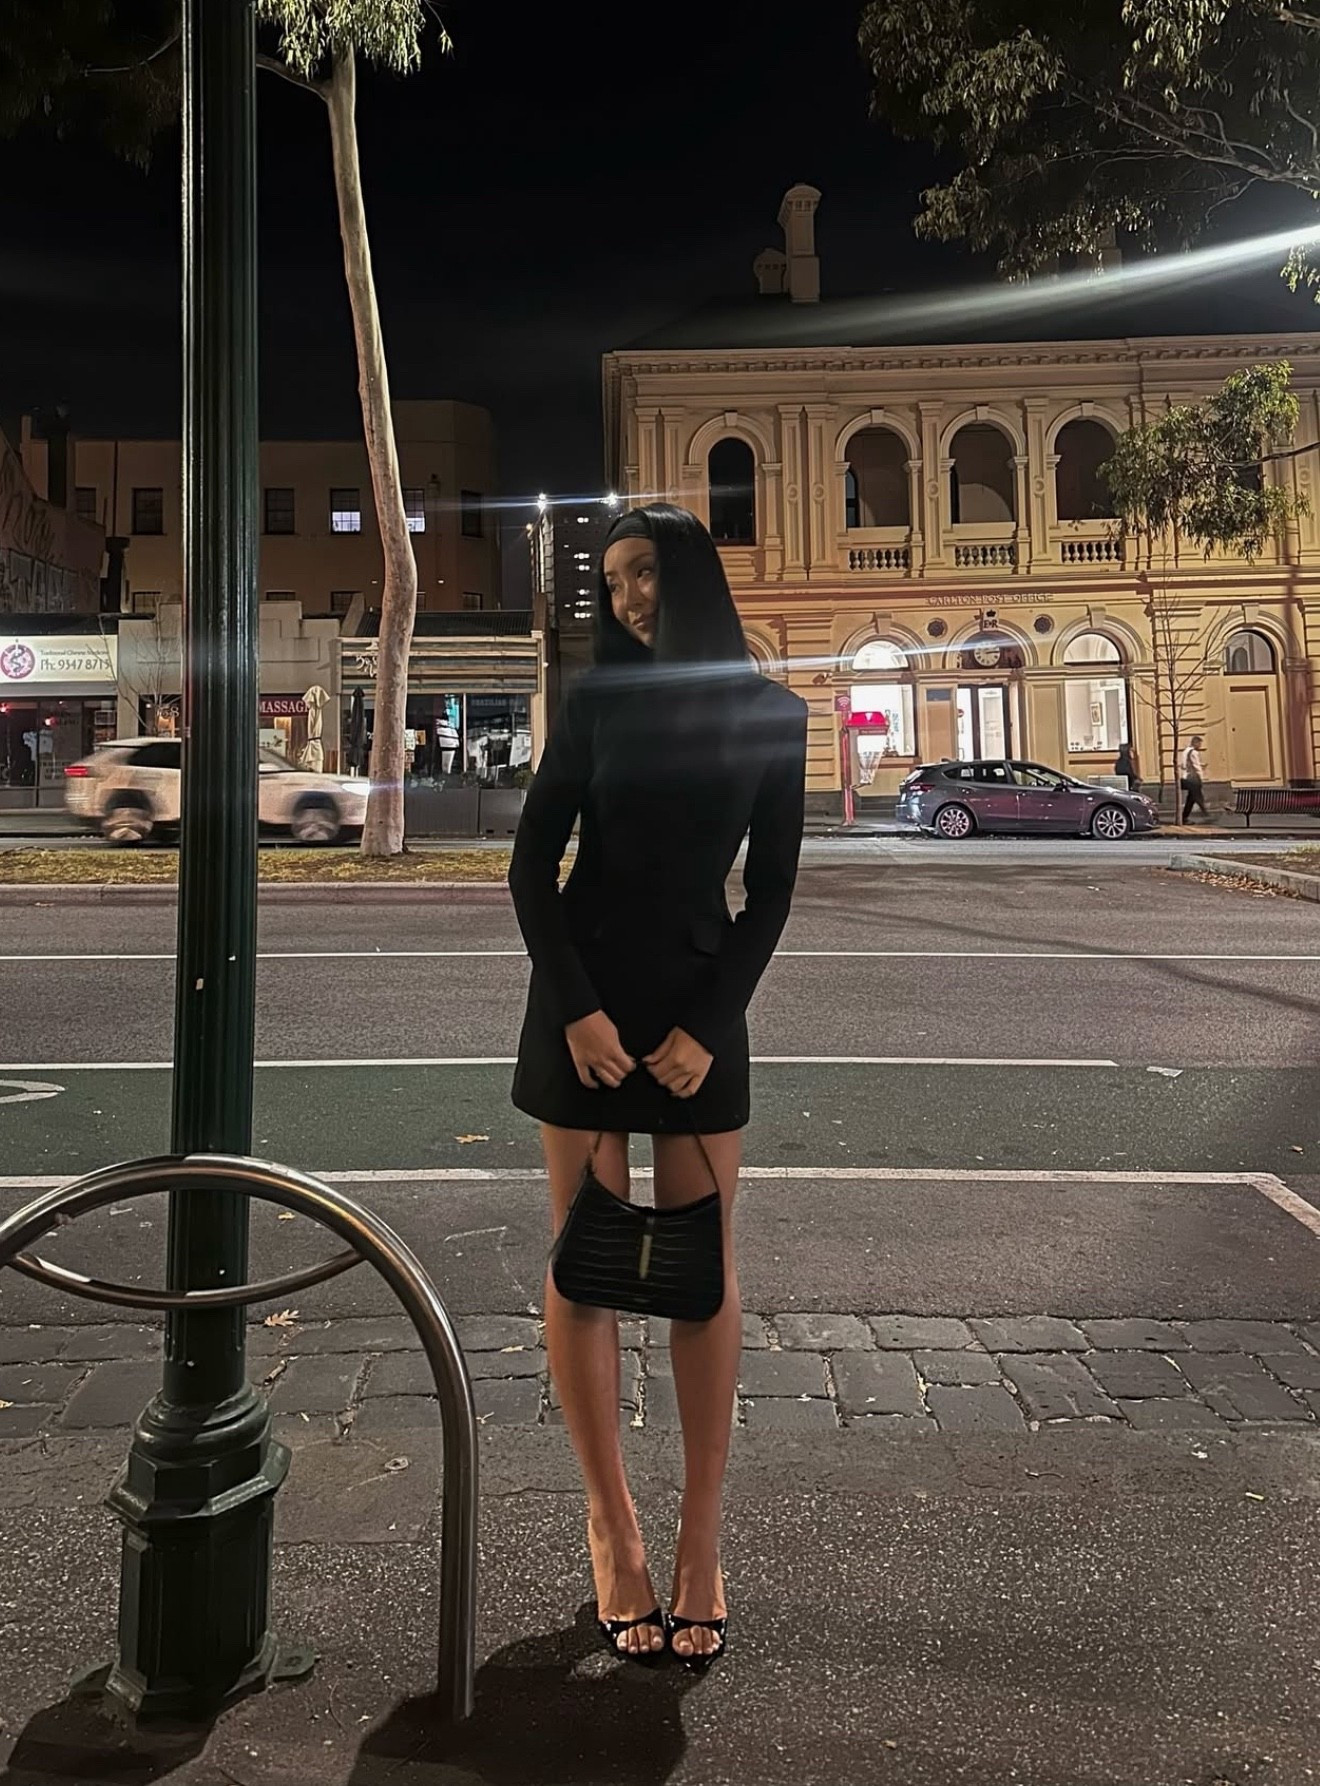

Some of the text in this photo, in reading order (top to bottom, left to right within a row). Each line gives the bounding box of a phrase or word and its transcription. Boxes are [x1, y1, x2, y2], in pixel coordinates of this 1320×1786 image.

[928, 592, 1054, 606] CARLTON POST OFFICE
